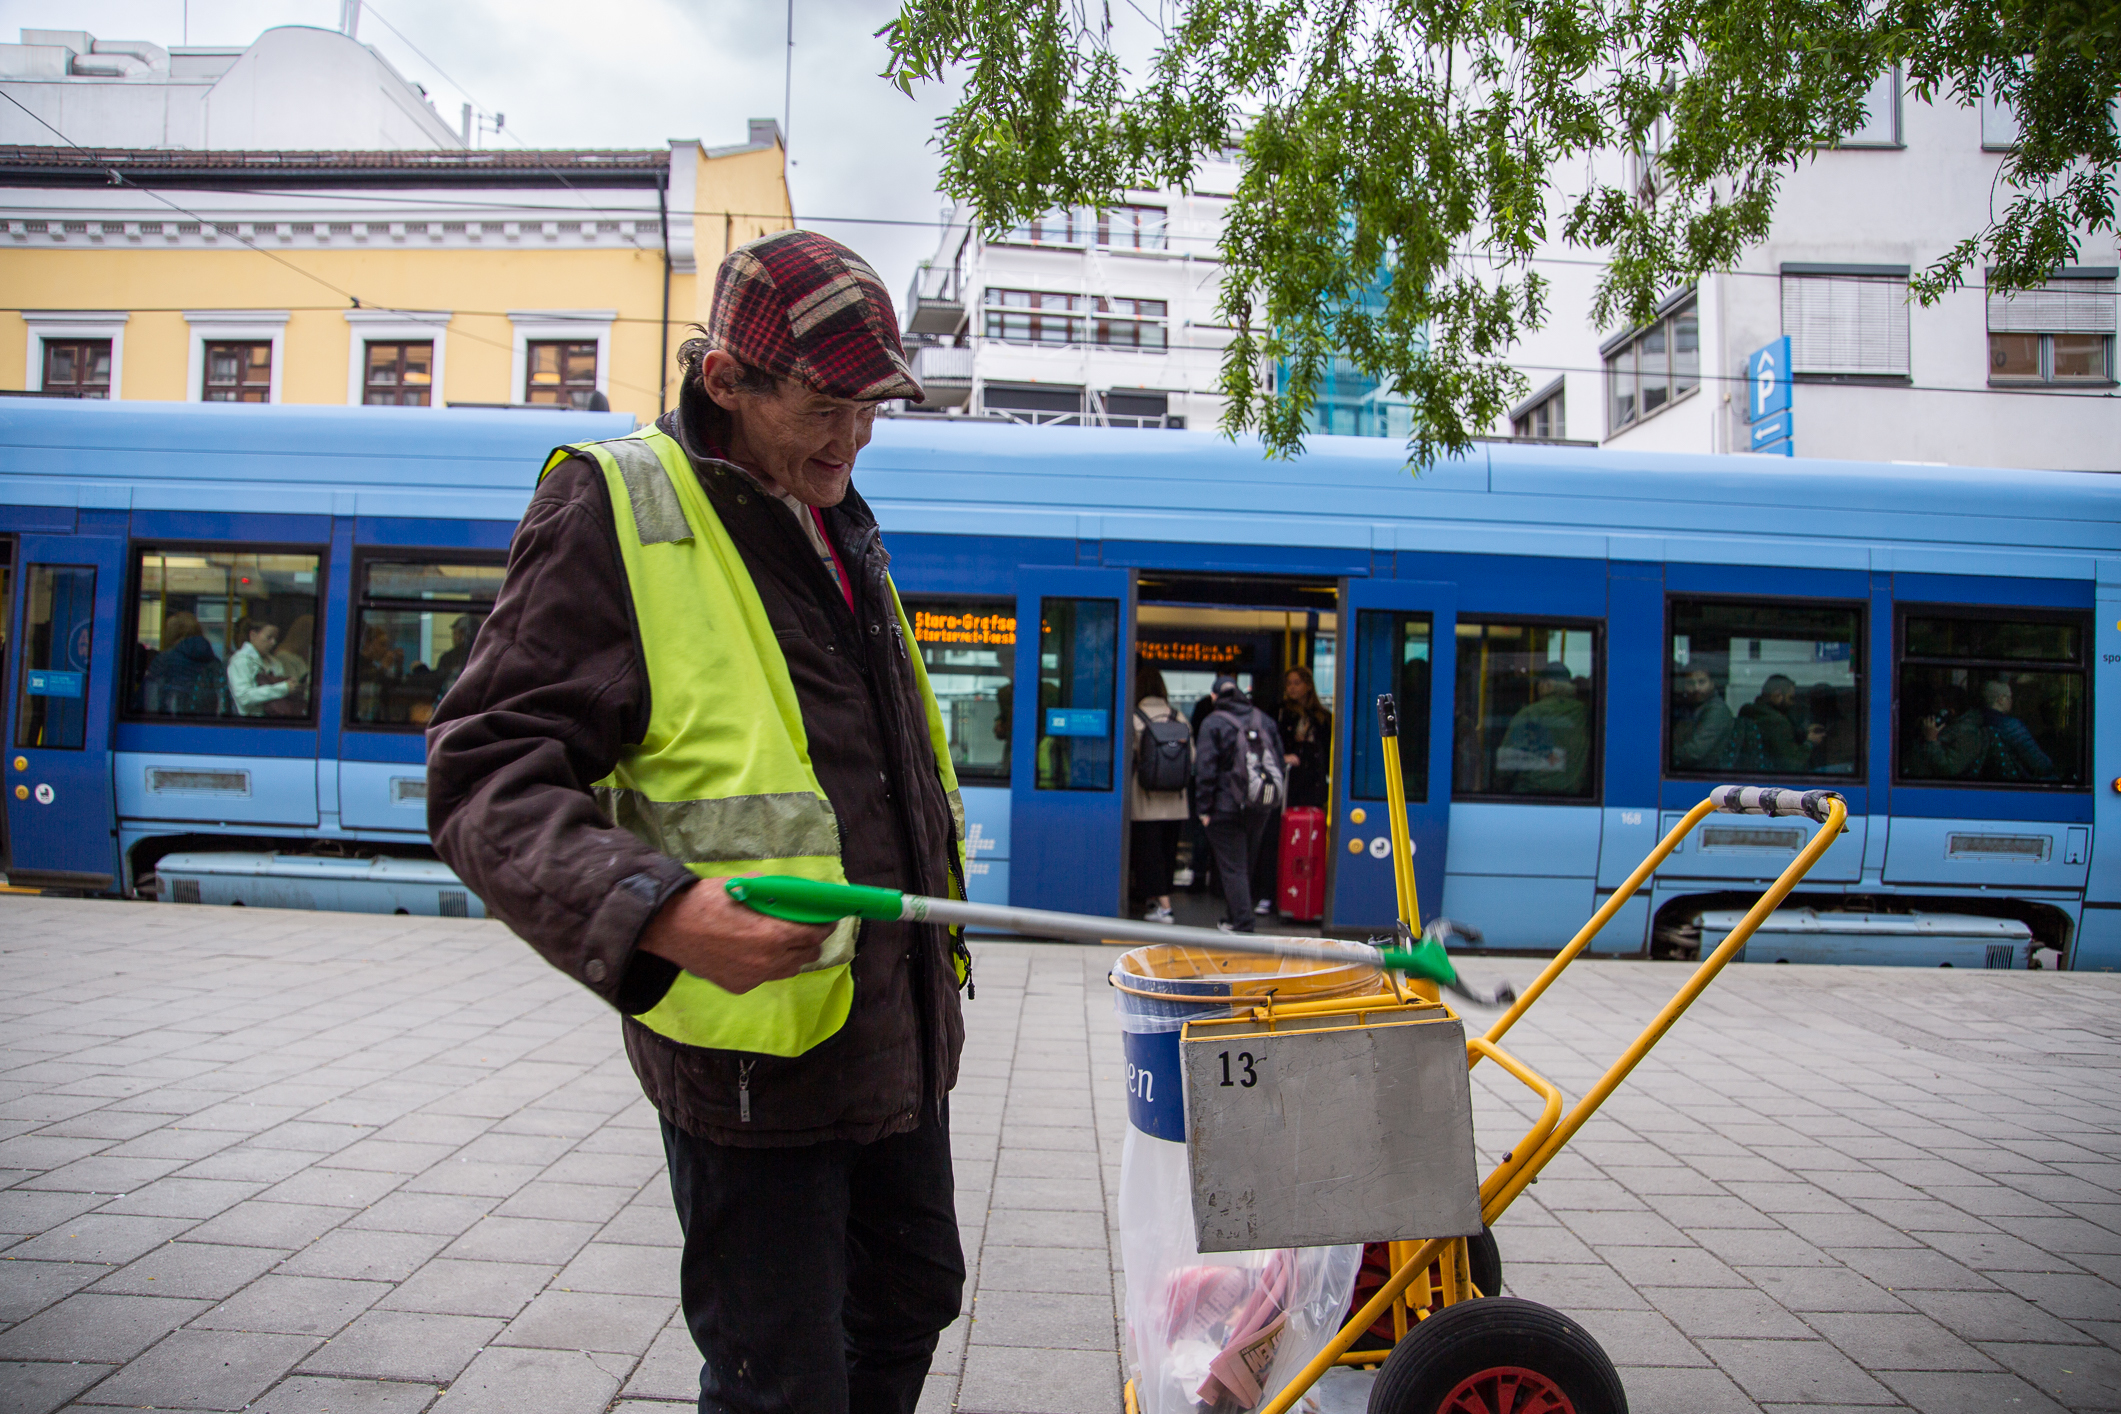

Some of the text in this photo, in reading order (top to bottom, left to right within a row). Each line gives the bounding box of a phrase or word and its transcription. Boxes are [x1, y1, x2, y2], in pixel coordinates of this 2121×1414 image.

[1757, 369, 1776, 415] P
[1621, 811, 1642, 825] 168
[1218, 1050, 1258, 1088] 13
